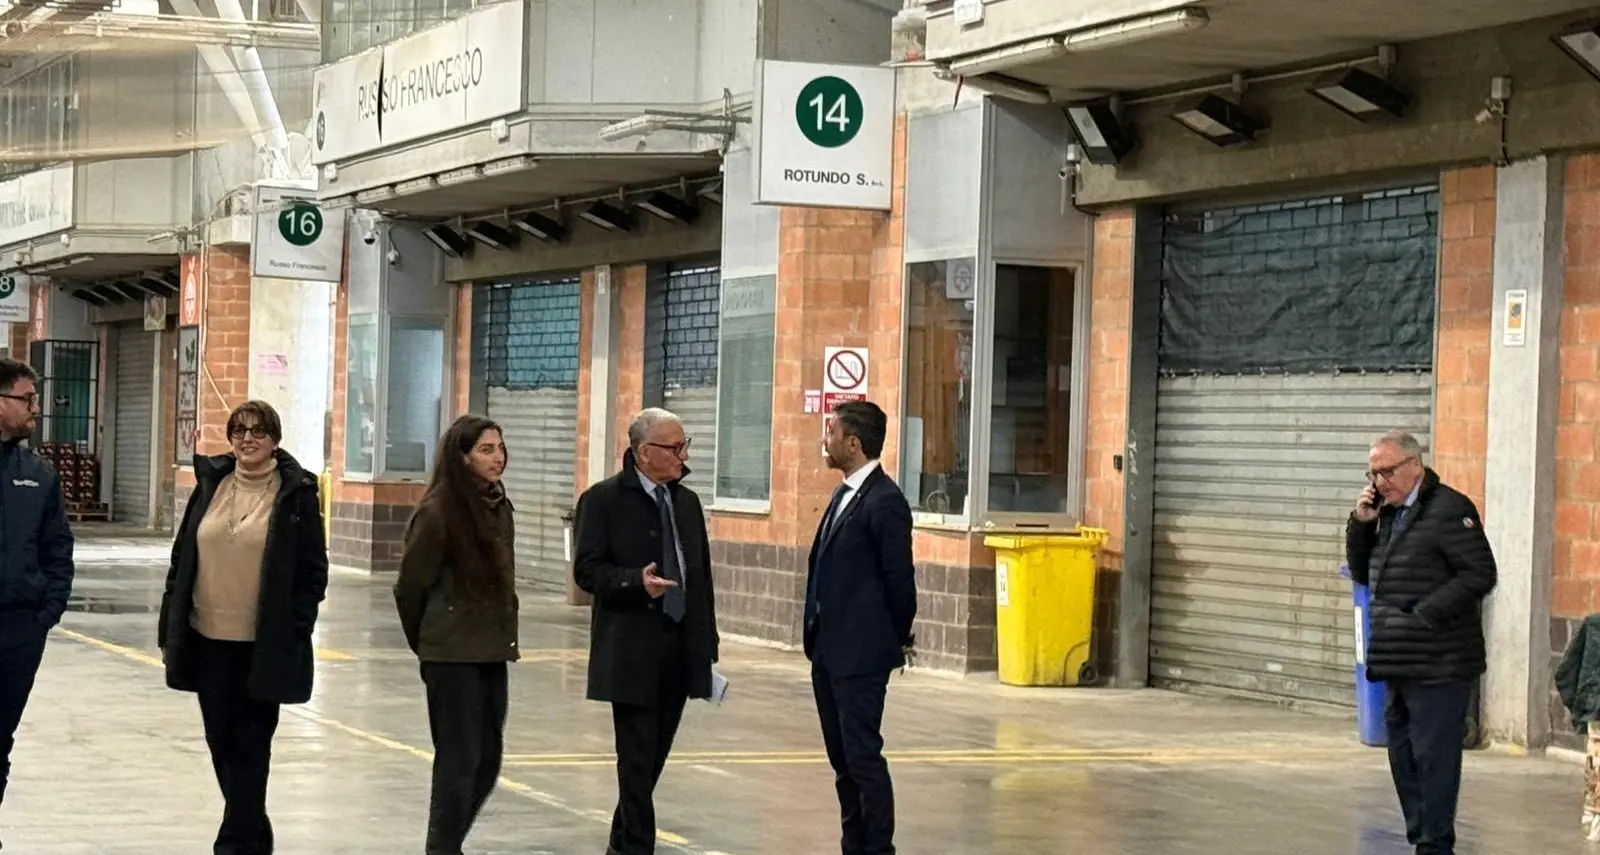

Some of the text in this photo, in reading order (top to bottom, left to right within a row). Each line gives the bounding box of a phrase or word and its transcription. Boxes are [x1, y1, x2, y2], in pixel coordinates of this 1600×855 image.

[357, 47, 483, 122] RUSSO FRANCESCO
[808, 92, 850, 132] 14
[783, 168, 851, 185] ROTUNDO
[856, 173, 869, 186] S.
[285, 210, 317, 237] 16
[269, 260, 291, 269] Russo
